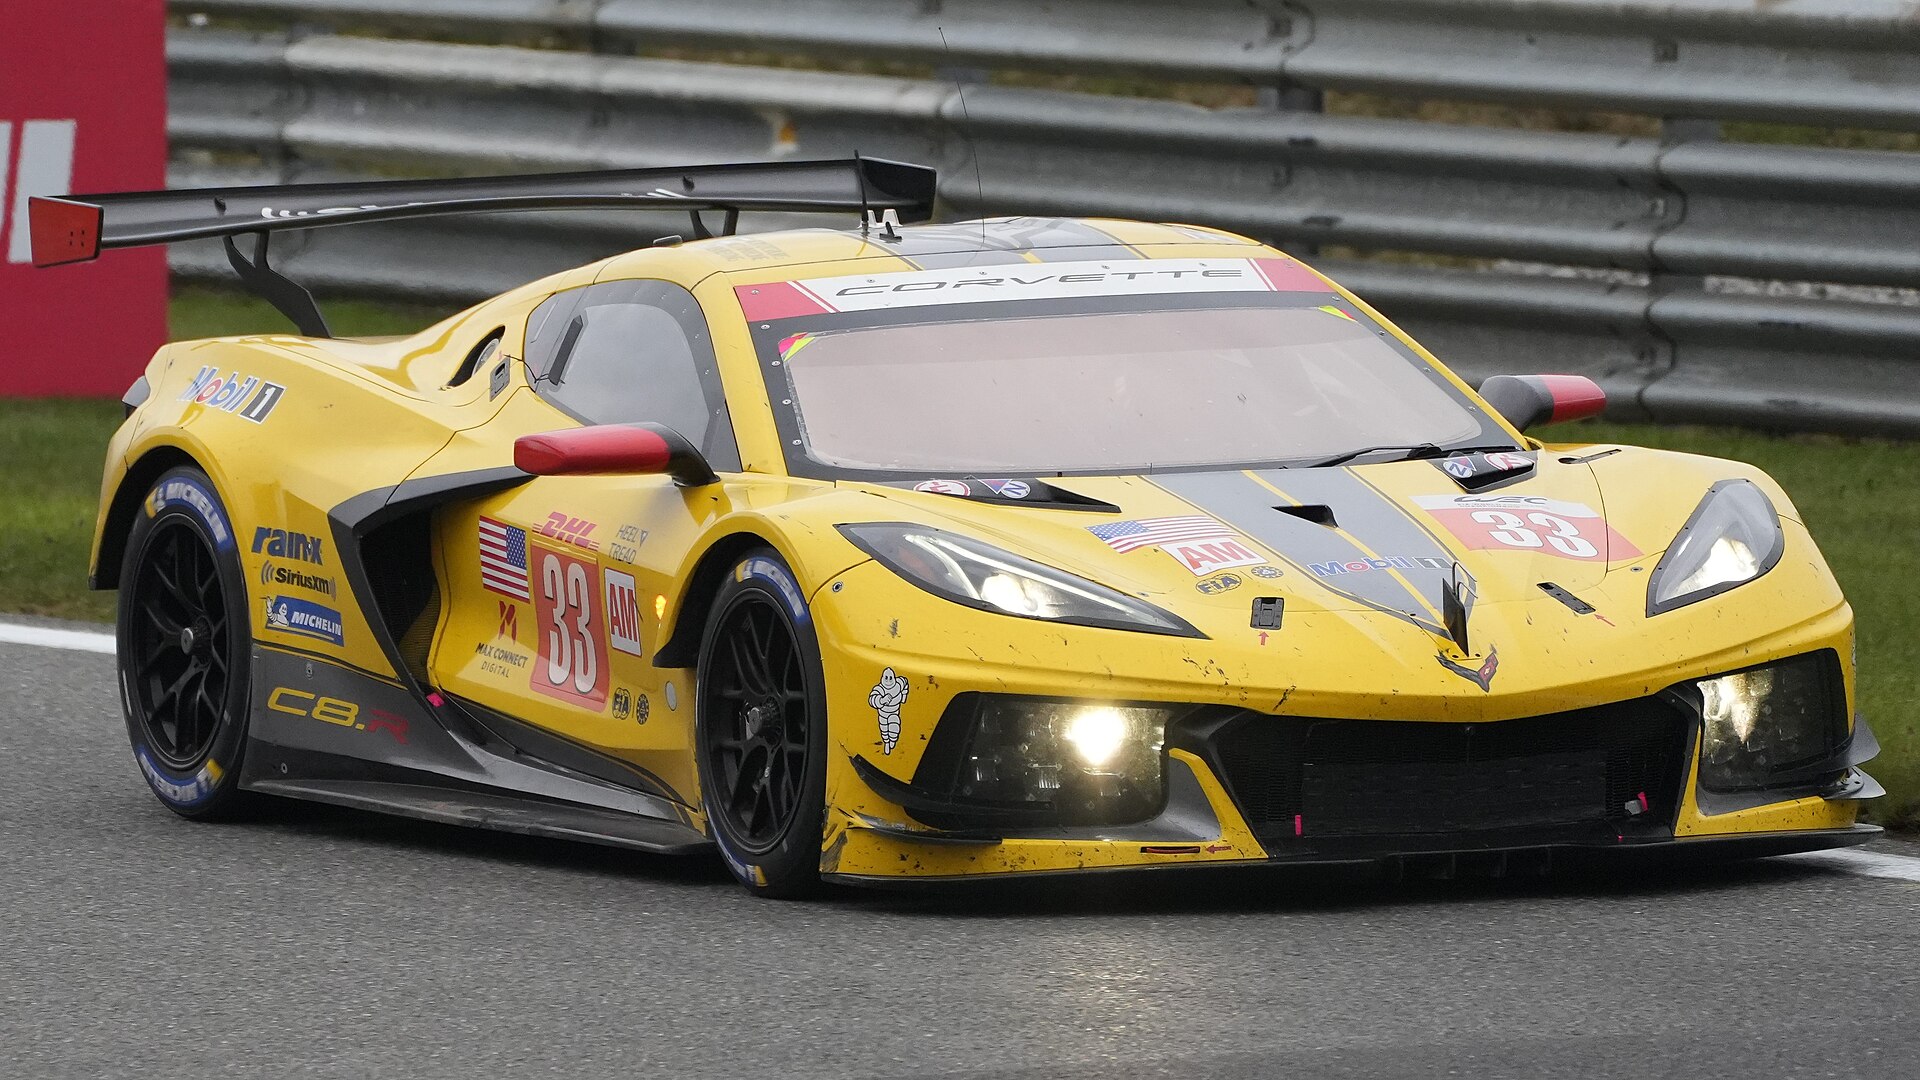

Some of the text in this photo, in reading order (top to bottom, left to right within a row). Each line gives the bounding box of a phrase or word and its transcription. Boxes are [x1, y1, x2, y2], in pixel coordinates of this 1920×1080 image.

[835, 268, 1243, 297] CORVETTE
[180, 365, 260, 413] Mobil
[540, 511, 597, 549] DHL
[1470, 511, 1599, 557] 33
[608, 542, 637, 565] TREAD
[1177, 540, 1257, 570] AM
[1307, 556, 1415, 578] Mobil
[1196, 574, 1241, 595] FIA
[290, 611, 342, 636] MICHELIN
[542, 553, 597, 694] 33
[609, 583, 639, 643] AM
[474, 642, 529, 669] MAX CONNECT
[481, 661, 510, 678] DIGITAL
[267, 686, 410, 745] C8.R
[613, 691, 631, 716] FIA
